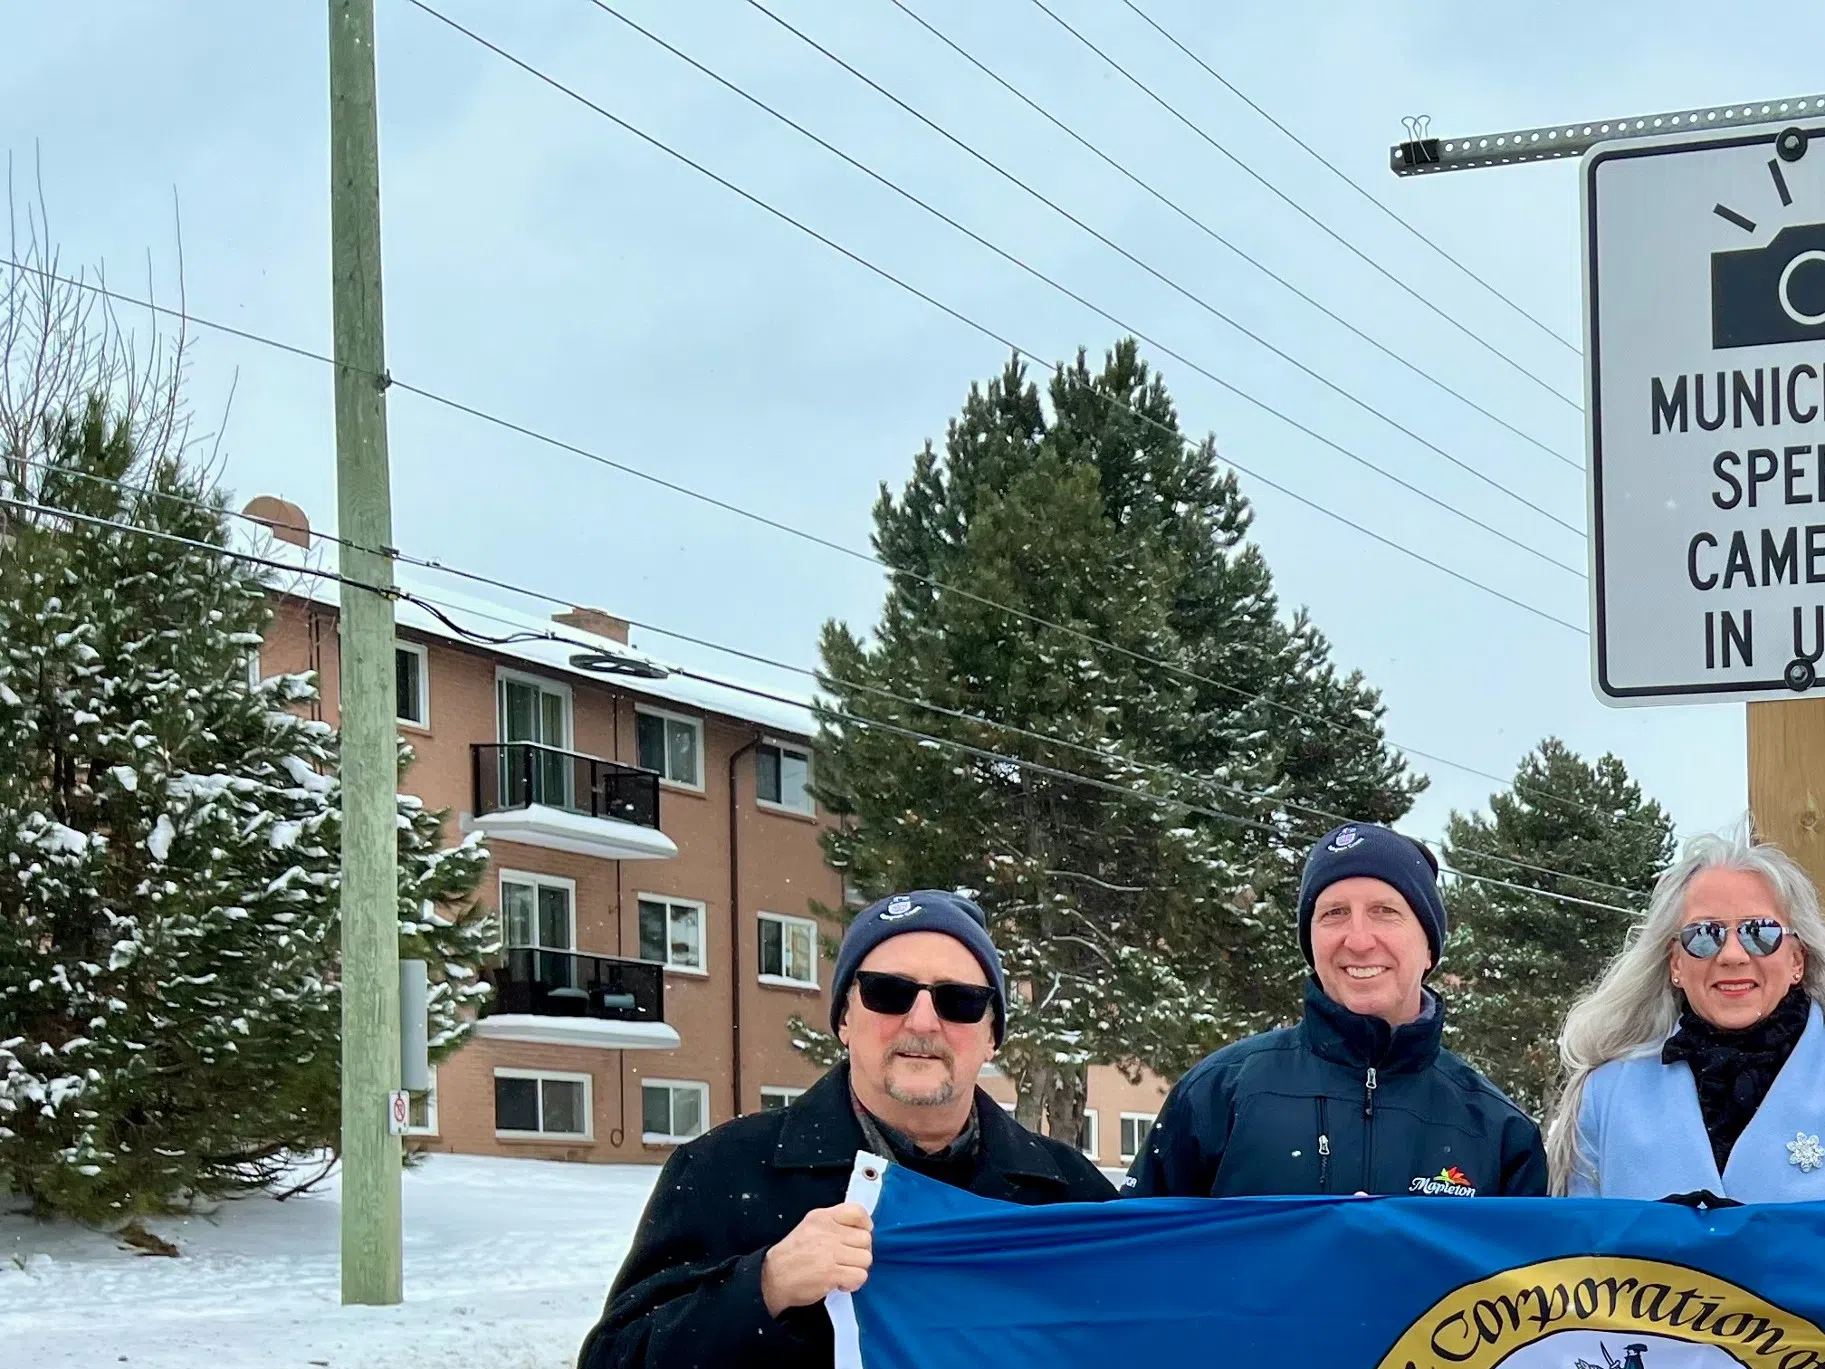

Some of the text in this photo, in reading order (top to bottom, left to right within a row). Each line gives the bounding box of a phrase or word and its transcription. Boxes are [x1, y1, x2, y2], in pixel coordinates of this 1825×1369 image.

[1705, 609, 1754, 669] IN
[1408, 1177, 1476, 1198] Mapleton
[1431, 1277, 1792, 1362] Corporation
